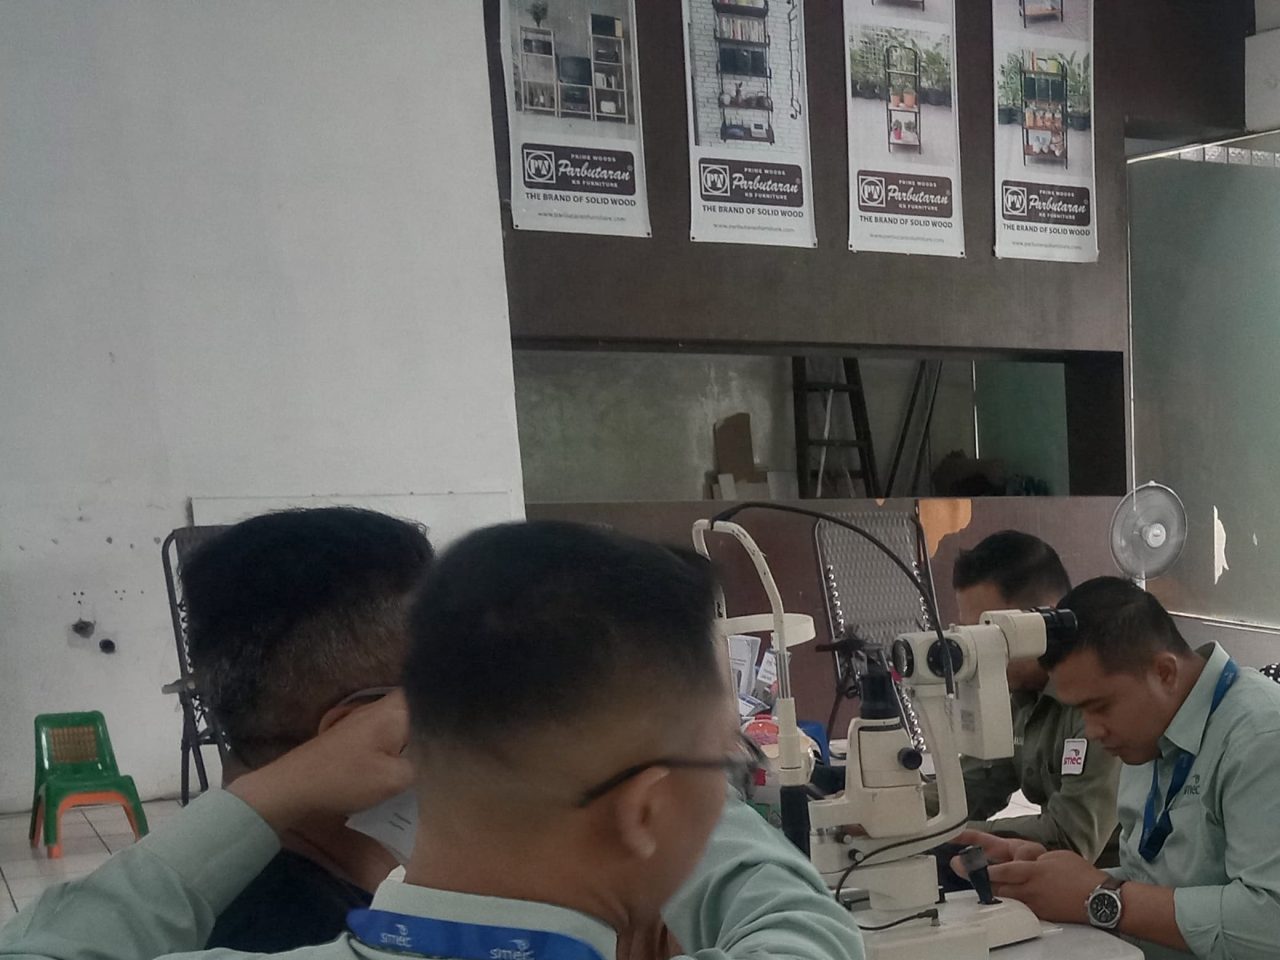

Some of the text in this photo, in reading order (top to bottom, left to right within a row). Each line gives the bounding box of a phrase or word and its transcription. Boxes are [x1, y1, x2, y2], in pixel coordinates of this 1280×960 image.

[525, 192, 636, 206] THE BRAND OF SOLID WOOD
[702, 205, 804, 218] THE BRAND OF SOLID WOOD
[859, 215, 873, 223] THE
[874, 216, 898, 225] BRAND
[931, 221, 953, 229] WOOD
[1003, 223, 1015, 231] THE
[1016, 224, 1038, 233] BRAND
[1049, 227, 1068, 235] SOLID
[1069, 228, 1091, 236] WOOD
[380, 932, 412, 948] smec
